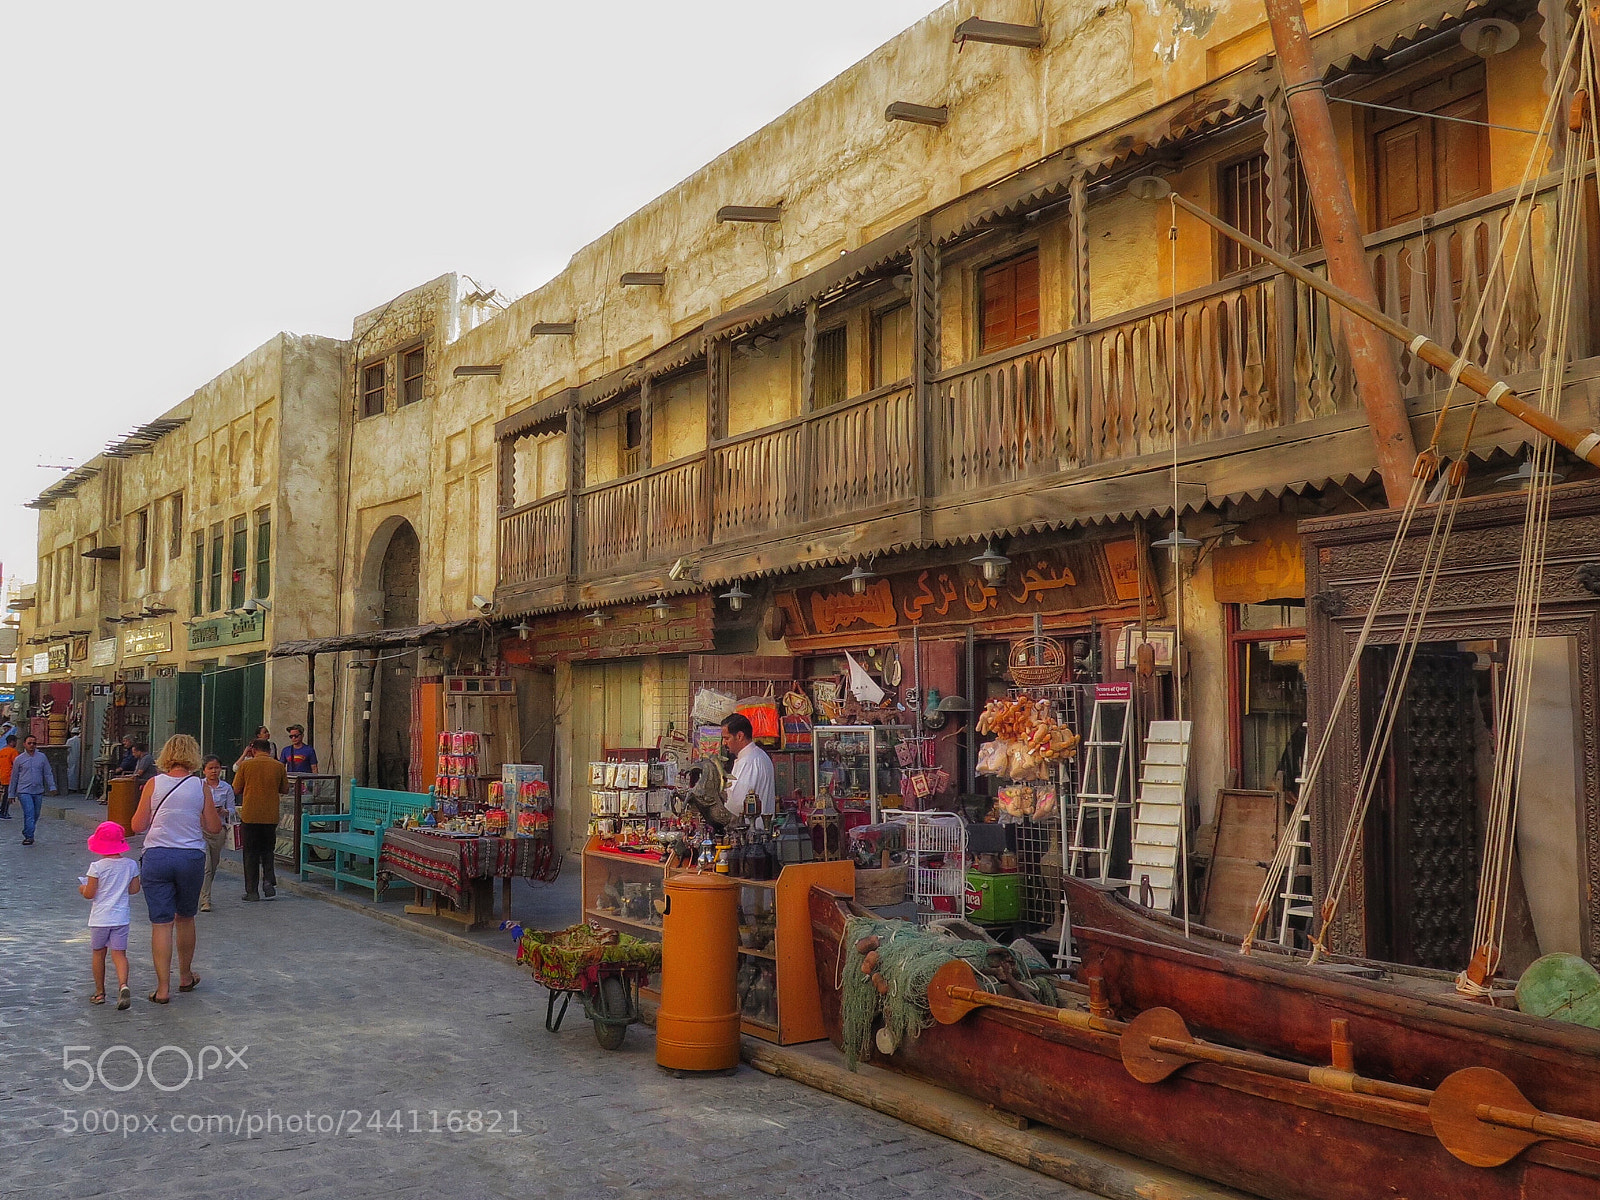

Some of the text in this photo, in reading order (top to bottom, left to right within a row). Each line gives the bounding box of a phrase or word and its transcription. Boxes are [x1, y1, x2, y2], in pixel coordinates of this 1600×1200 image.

[903, 570, 957, 625] تركي
[965, 578, 998, 612] بن
[1008, 561, 1076, 604] متجر
[589, 624, 697, 648] EXCHANGE
[965, 894, 980, 906] nca
